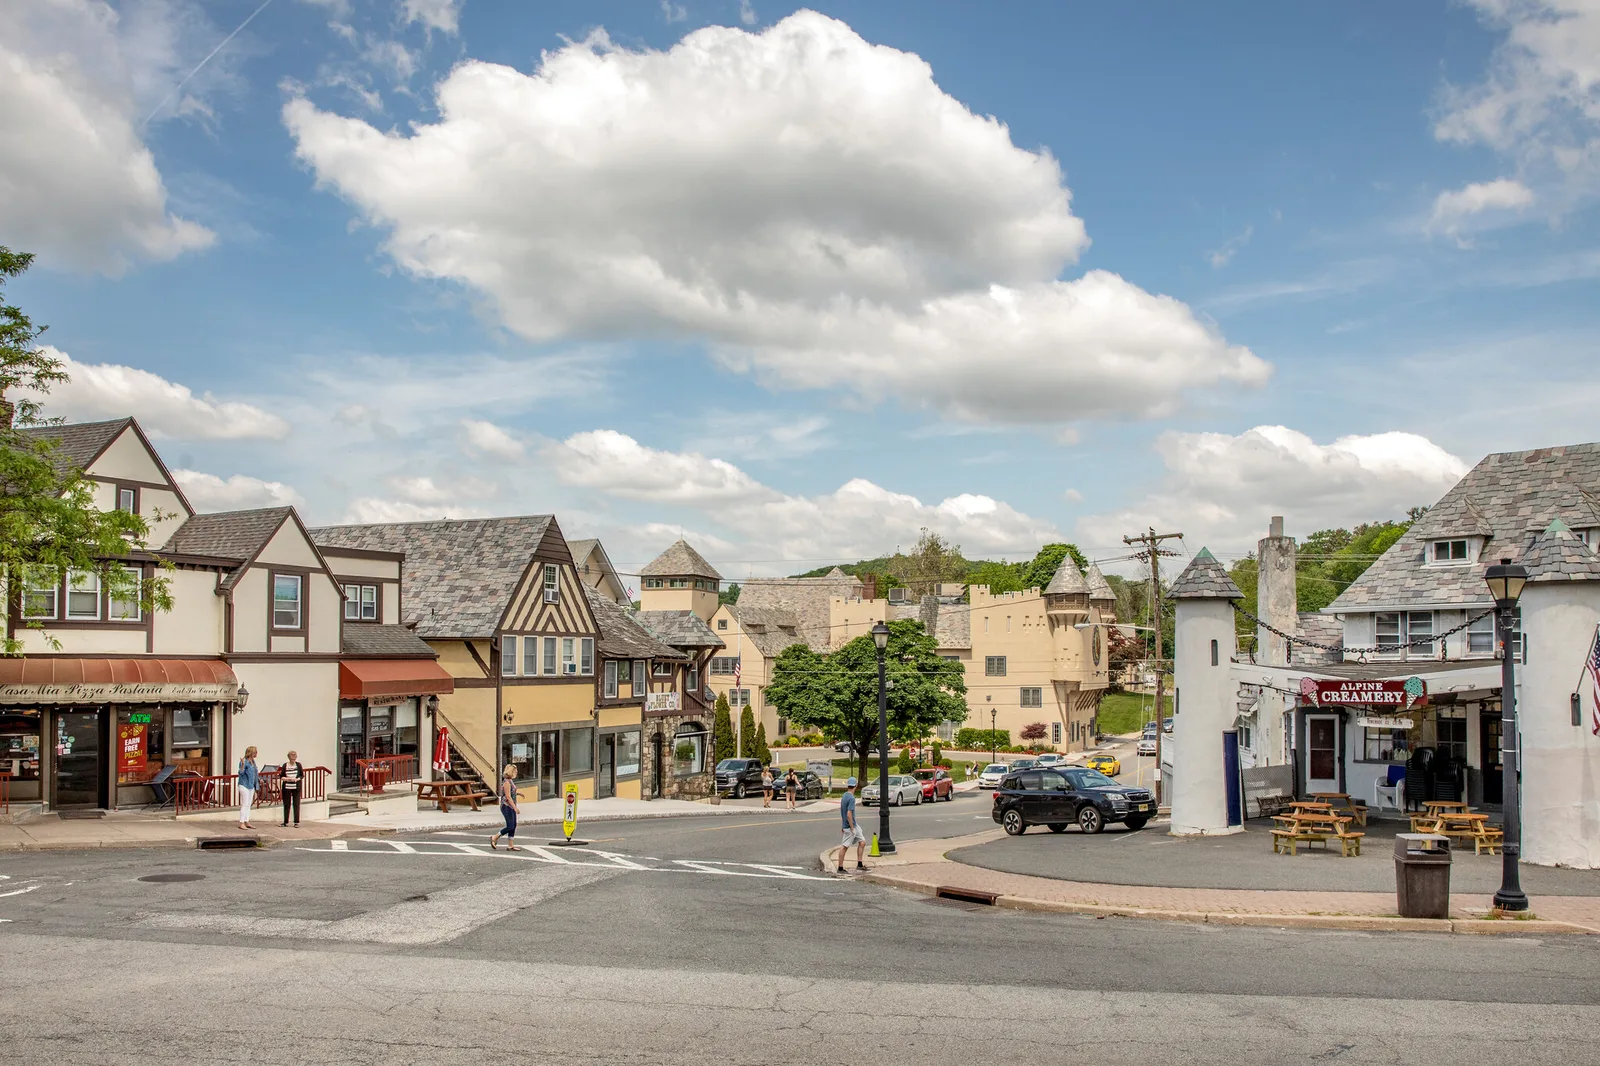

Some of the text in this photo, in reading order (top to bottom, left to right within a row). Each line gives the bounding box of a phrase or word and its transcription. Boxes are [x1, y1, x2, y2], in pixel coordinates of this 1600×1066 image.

[1340, 682, 1383, 691] ALPINE
[0, 684, 28, 695] Casa
[31, 684, 60, 695] Mia
[65, 684, 104, 699] Pizza
[1321, 691, 1404, 703] CREAMERY
[130, 713, 151, 723] ATM
[124, 737, 140, 746] EARN
[124, 744, 138, 753] FREE
[124, 750, 143, 759] PIZZA!
